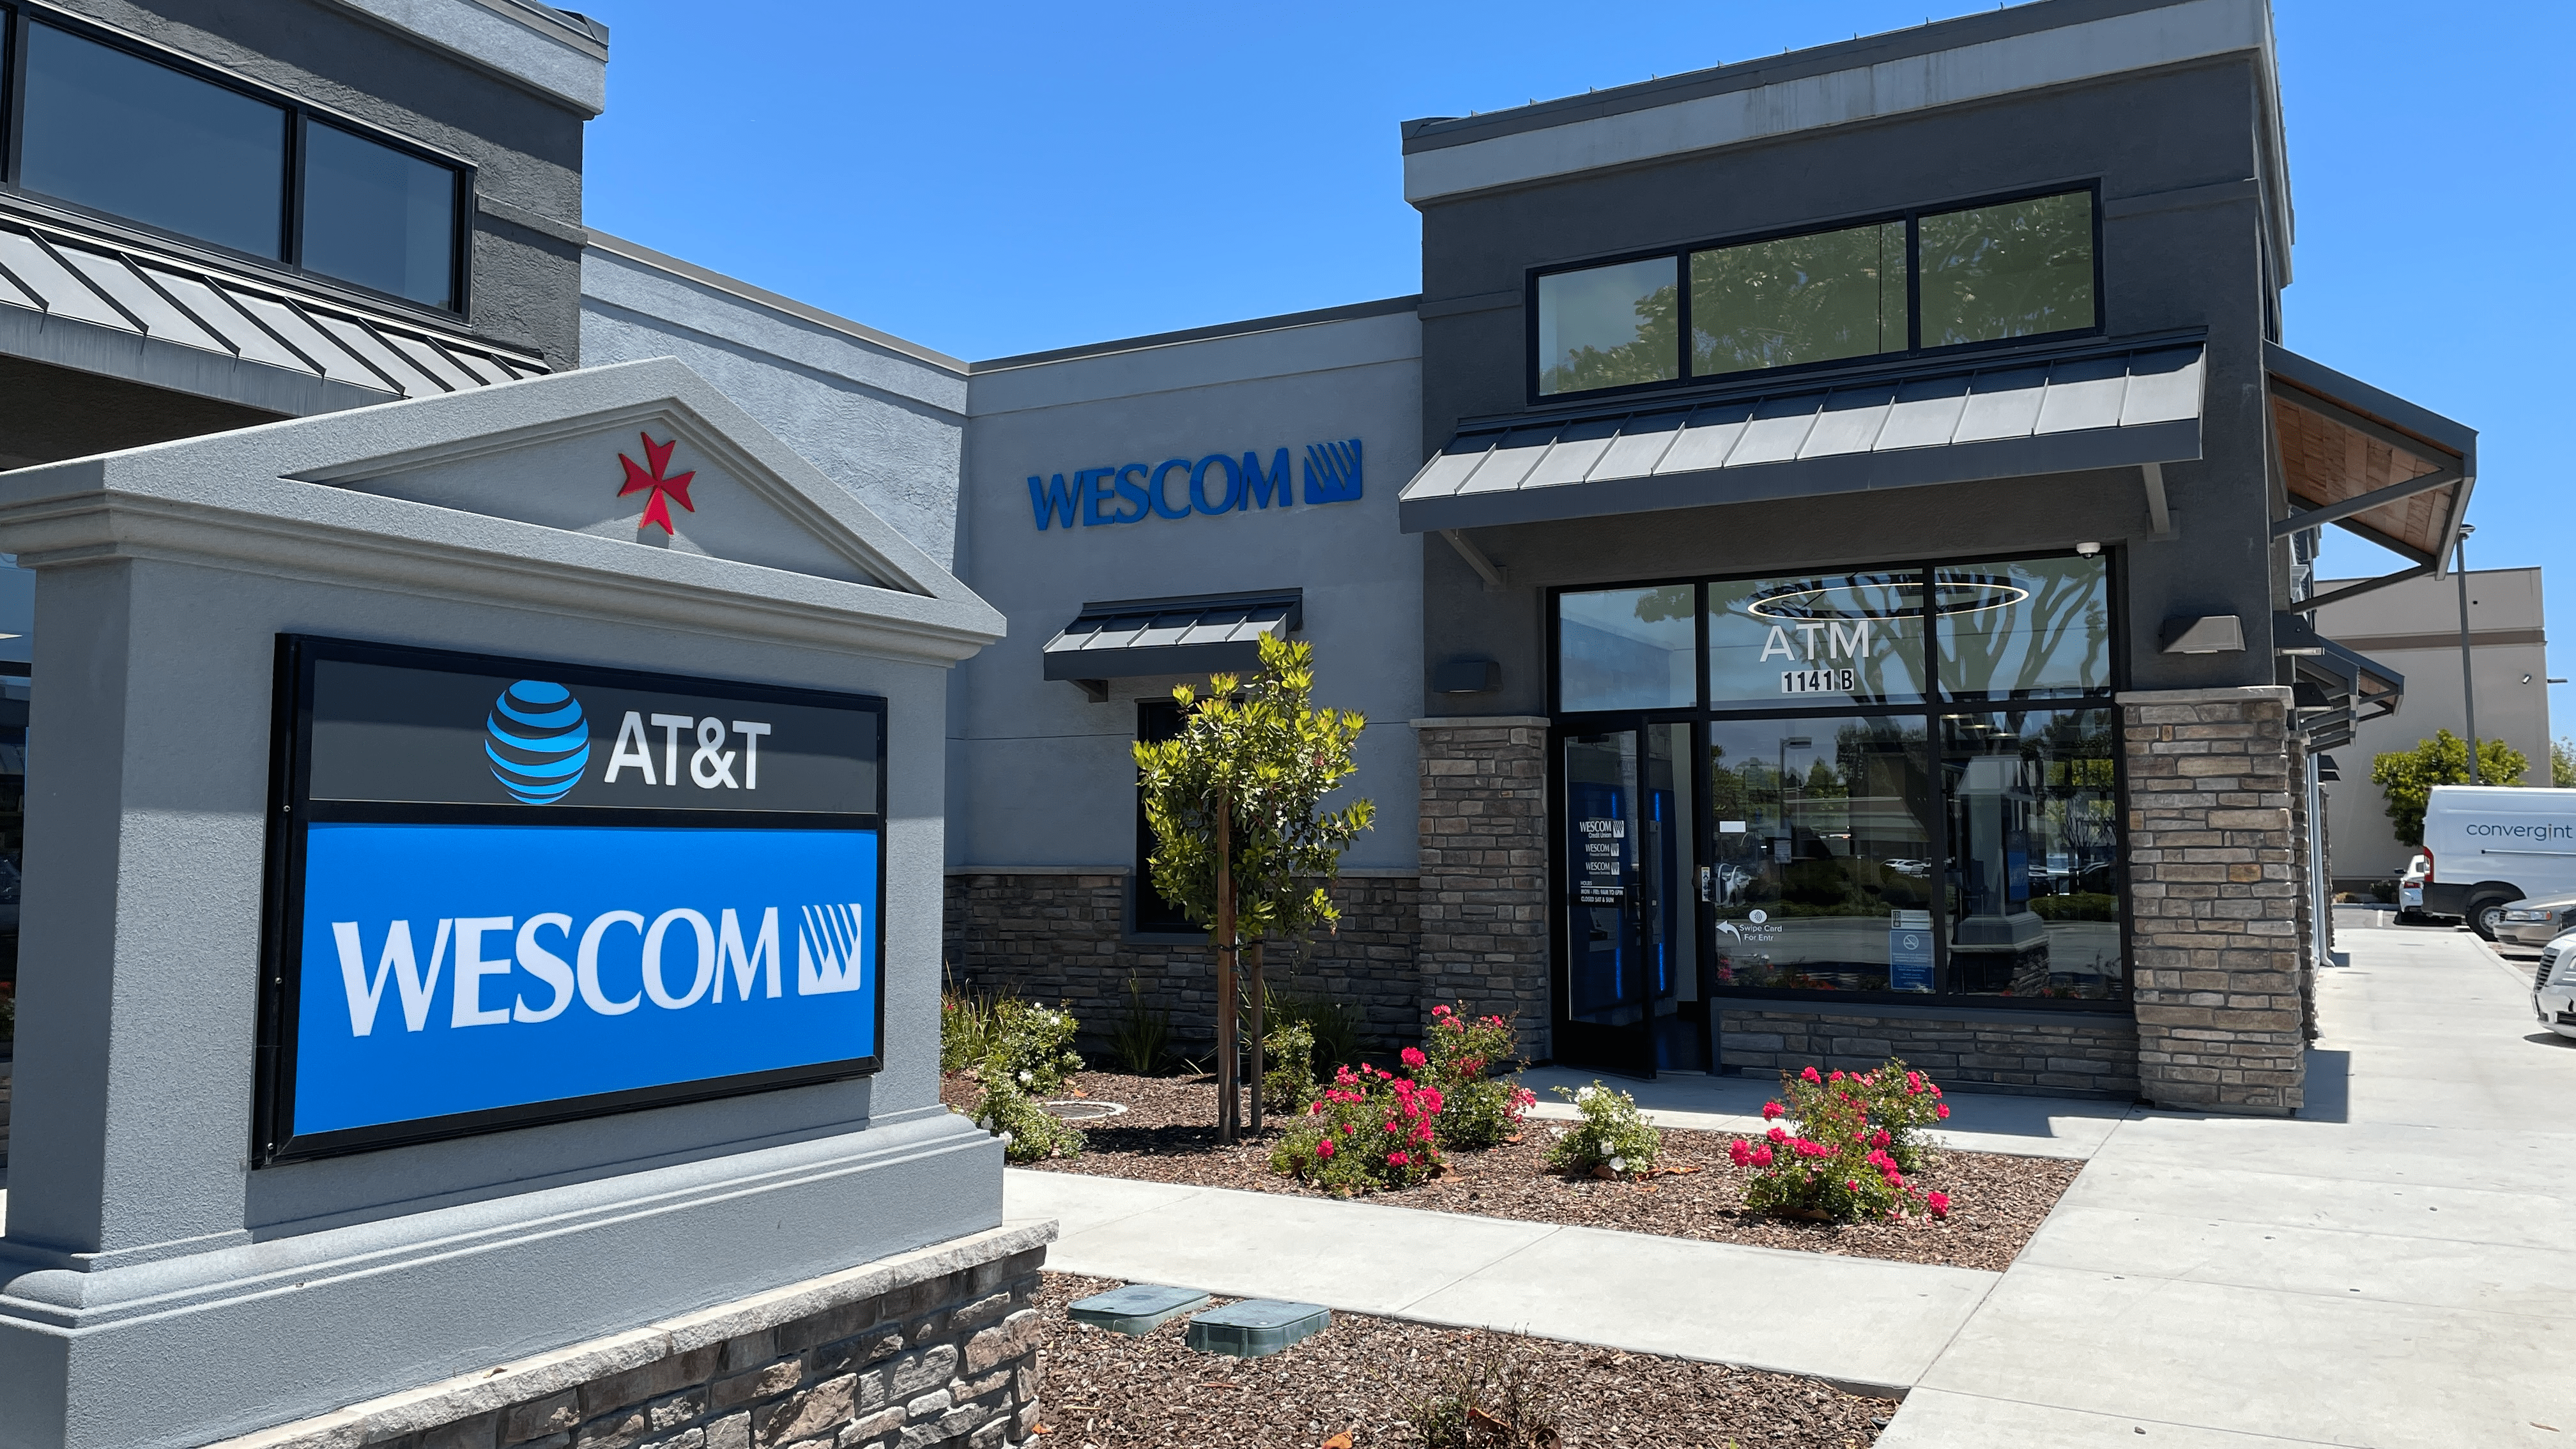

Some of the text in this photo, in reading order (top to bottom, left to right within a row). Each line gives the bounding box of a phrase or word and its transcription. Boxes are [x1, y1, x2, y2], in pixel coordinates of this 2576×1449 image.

[1027, 447, 1292, 531] WESCOM
[1759, 620, 1870, 663] ATM
[1784, 670, 1853, 692] 1141 B
[603, 710, 772, 790] AT&T
[1579, 820, 1611, 832] WESCOM
[2467, 824, 2573, 841] convergint
[1585, 843, 1610, 852] WESCOM
[1585, 862, 1610, 871] WESCOM
[1739, 924, 1763, 933] Swipe
[332, 906, 782, 1037] WESCOM
